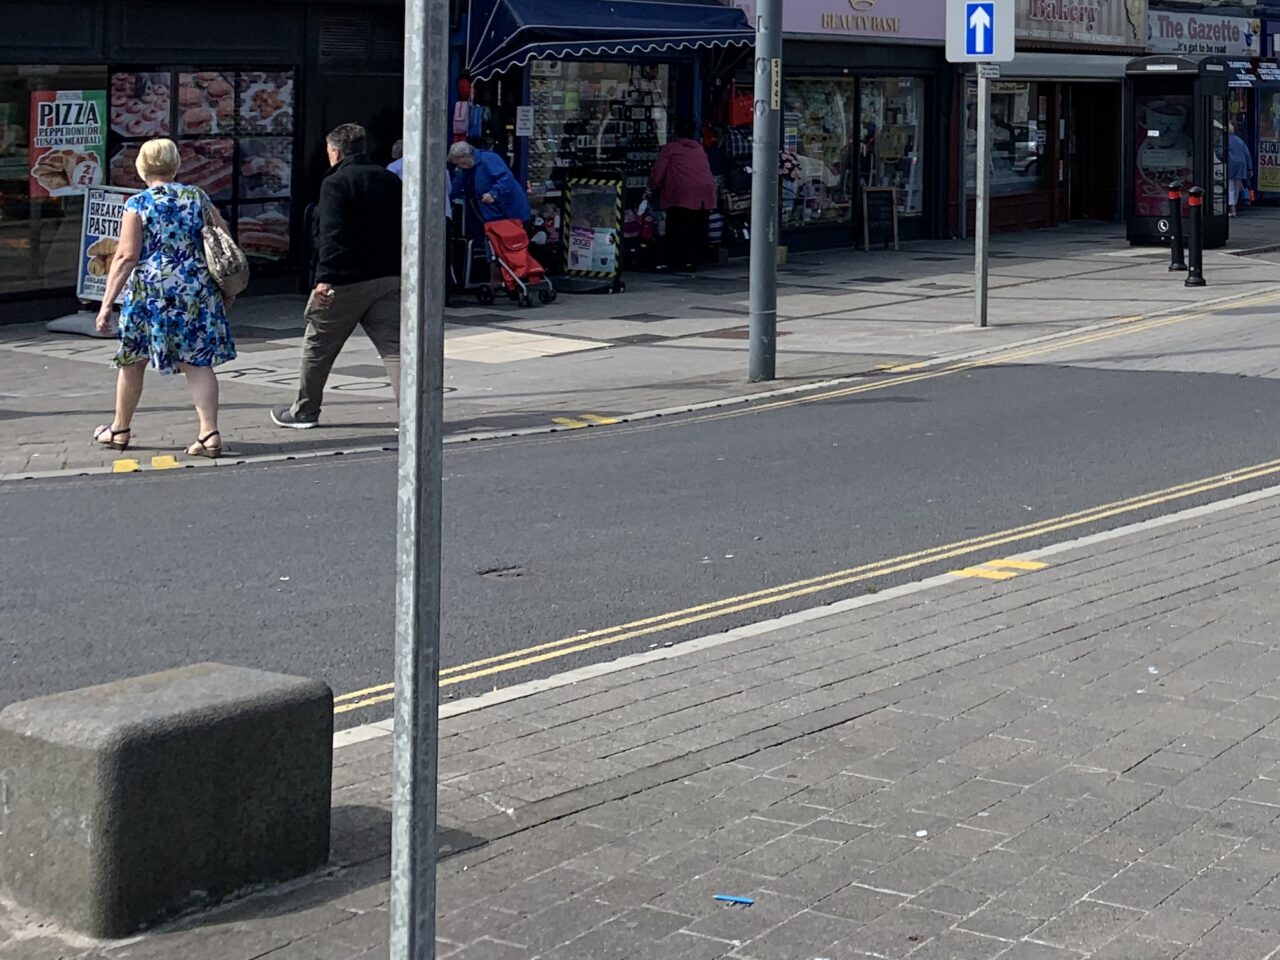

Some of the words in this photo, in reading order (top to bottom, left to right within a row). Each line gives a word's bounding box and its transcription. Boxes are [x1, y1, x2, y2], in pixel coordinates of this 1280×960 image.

[822, 13, 868, 31] BEAUTY
[871, 16, 900, 33] BASE
[1157, 15, 1183, 37] The
[1188, 17, 1240, 42] Gazette
[1188, 42, 1198, 53] got
[1200, 43, 1206, 52] to
[1206, 43, 1214, 53] be
[1214, 44, 1227, 53] read
[39, 102, 99, 125] PIZZA
[39, 127, 86, 137] PEPPERONI
[87, 126, 99, 135] OR
[36, 137, 64, 146] TUSCAN
